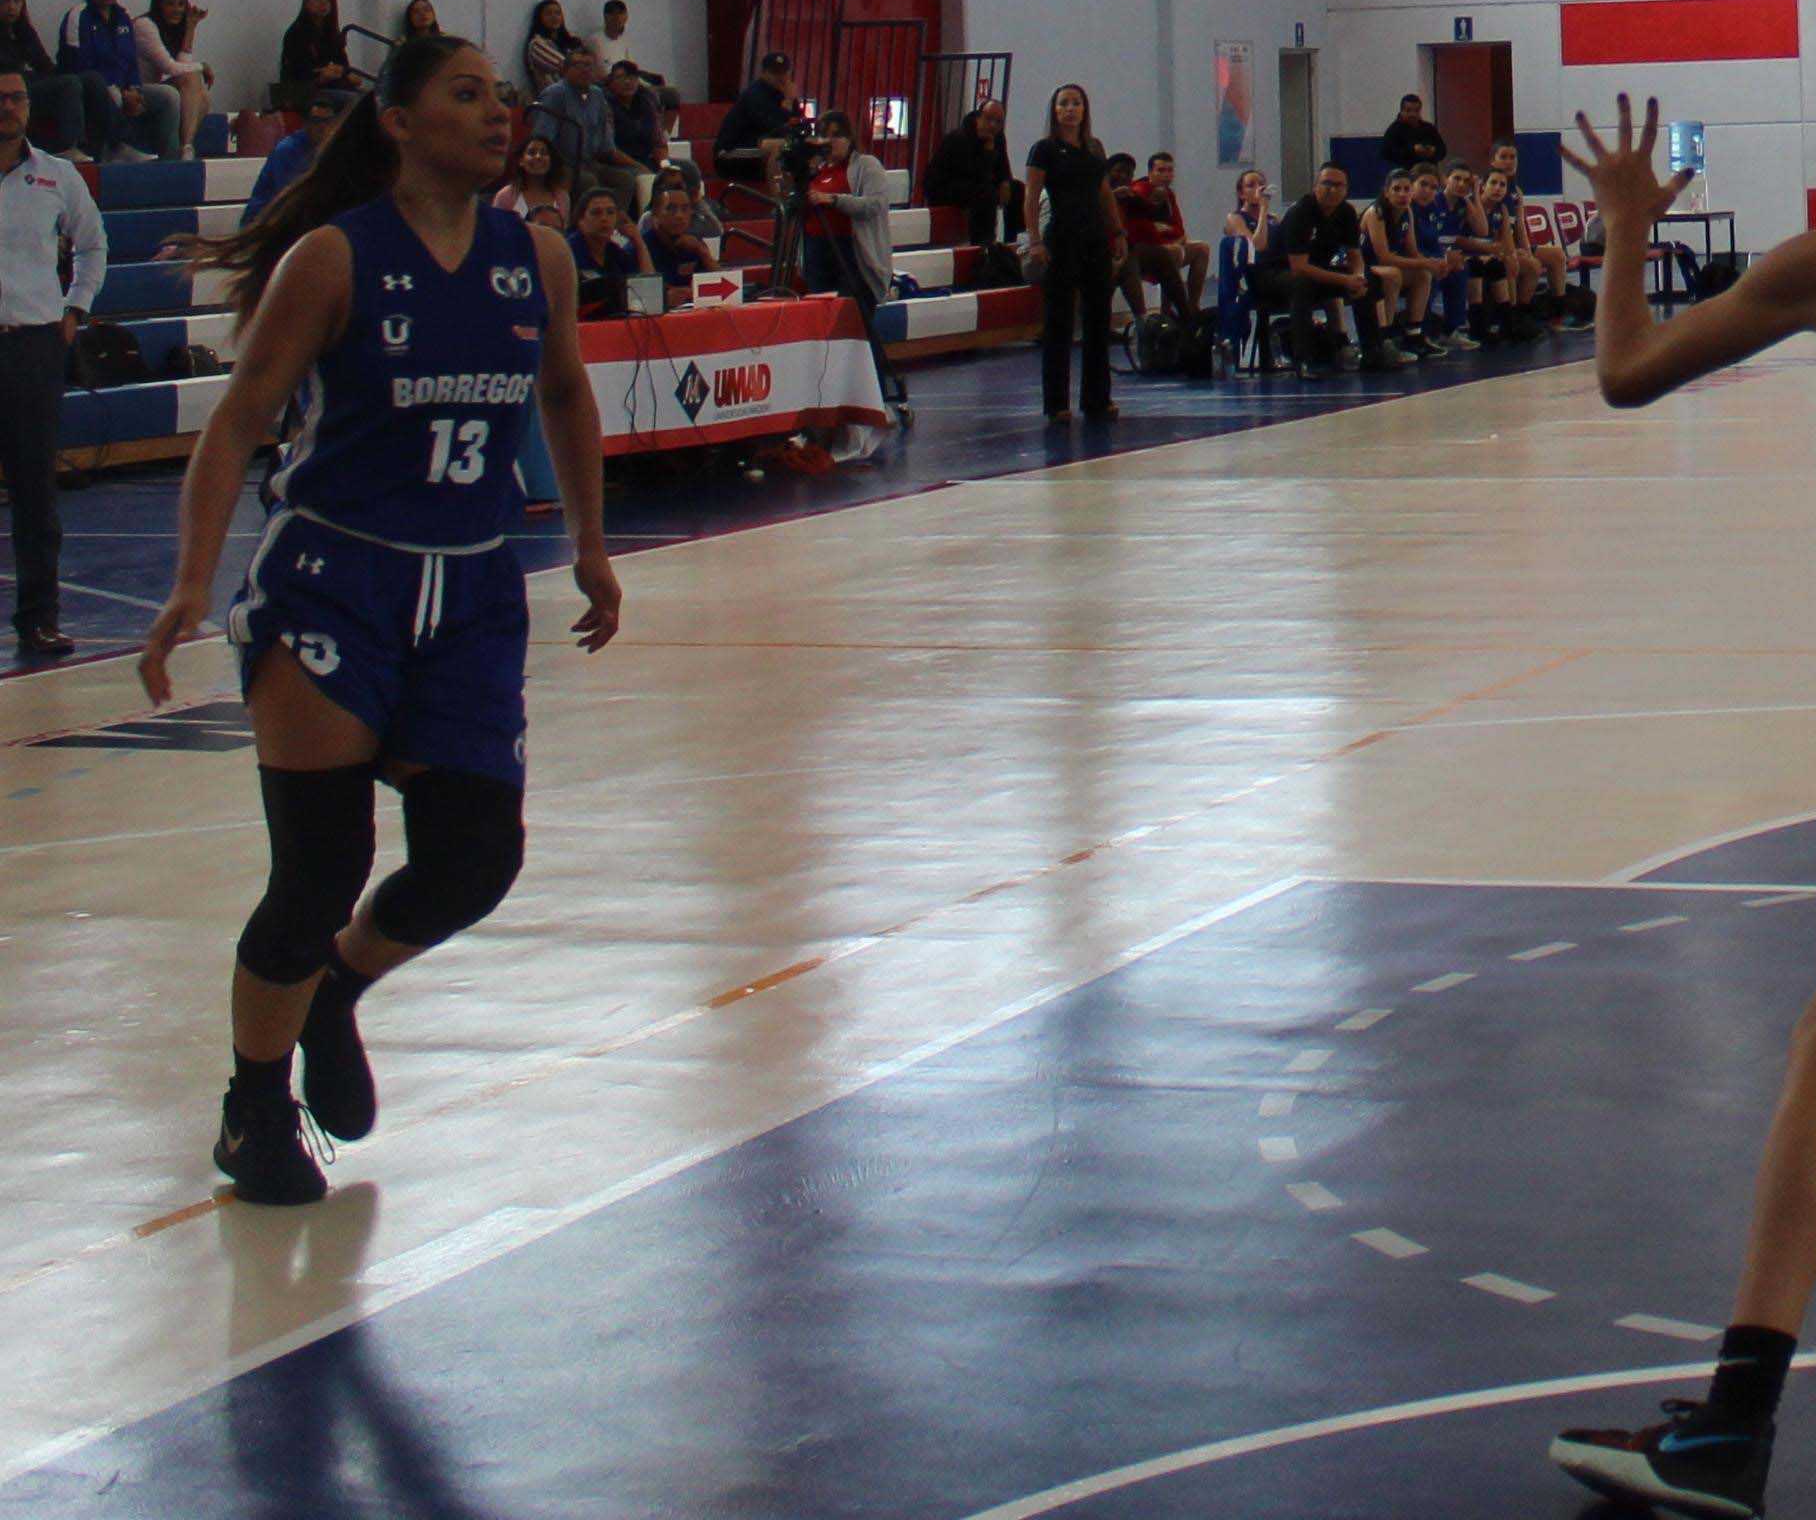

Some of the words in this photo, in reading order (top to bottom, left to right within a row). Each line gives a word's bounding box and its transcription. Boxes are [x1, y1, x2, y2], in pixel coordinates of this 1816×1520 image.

[392, 373, 534, 408] BORREGOS
[713, 363, 772, 408] UMAD
[426, 418, 490, 485] 13
